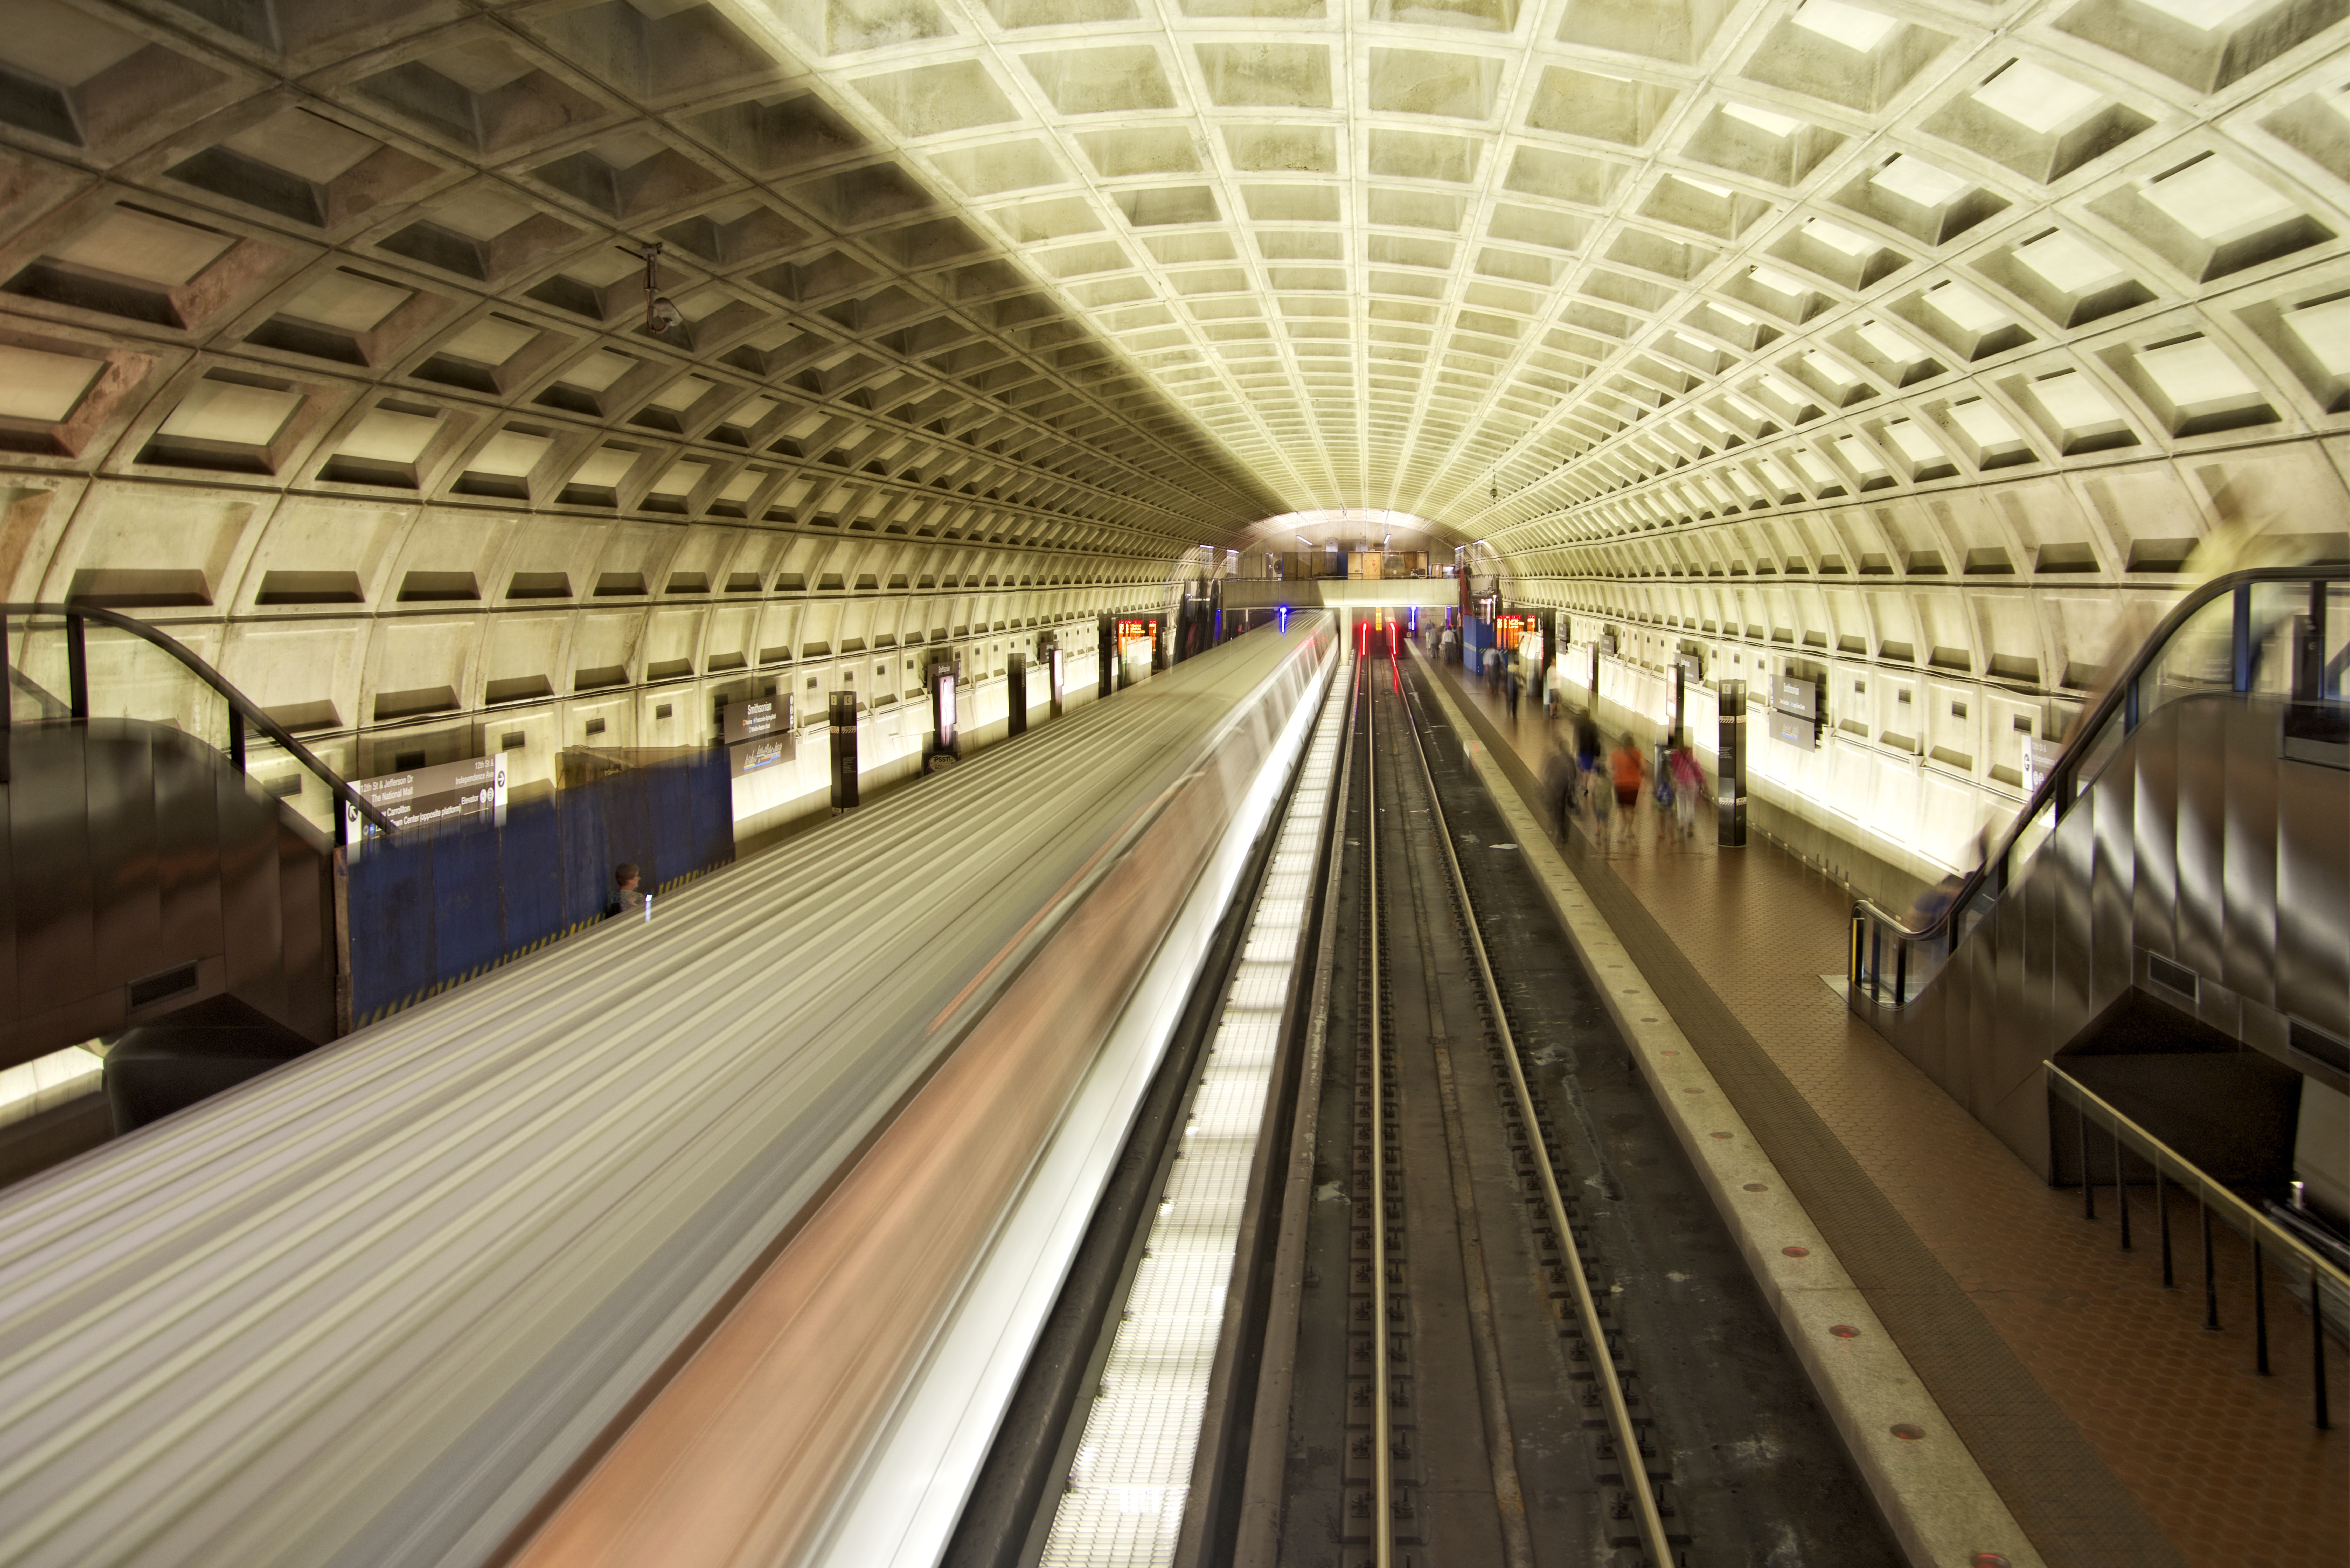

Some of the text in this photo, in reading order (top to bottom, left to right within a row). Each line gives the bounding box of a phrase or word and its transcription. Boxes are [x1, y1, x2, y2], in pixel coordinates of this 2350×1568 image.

[1783, 682, 1799, 695] Smithsonian
[748, 702, 772, 715] Smithsonian
[475, 761, 484, 769] 12th
[361, 775, 414, 792] 12th St & Jefferson Dr
[455, 773, 485, 785] Independence
[371, 786, 413, 803] The National Mall
[461, 795, 479, 805] Elevator
[387, 805, 411, 817] Carrollton
[403, 815, 419, 825] Center
[419, 809, 441, 823] (opposite
[441, 803, 461, 818] platform)
